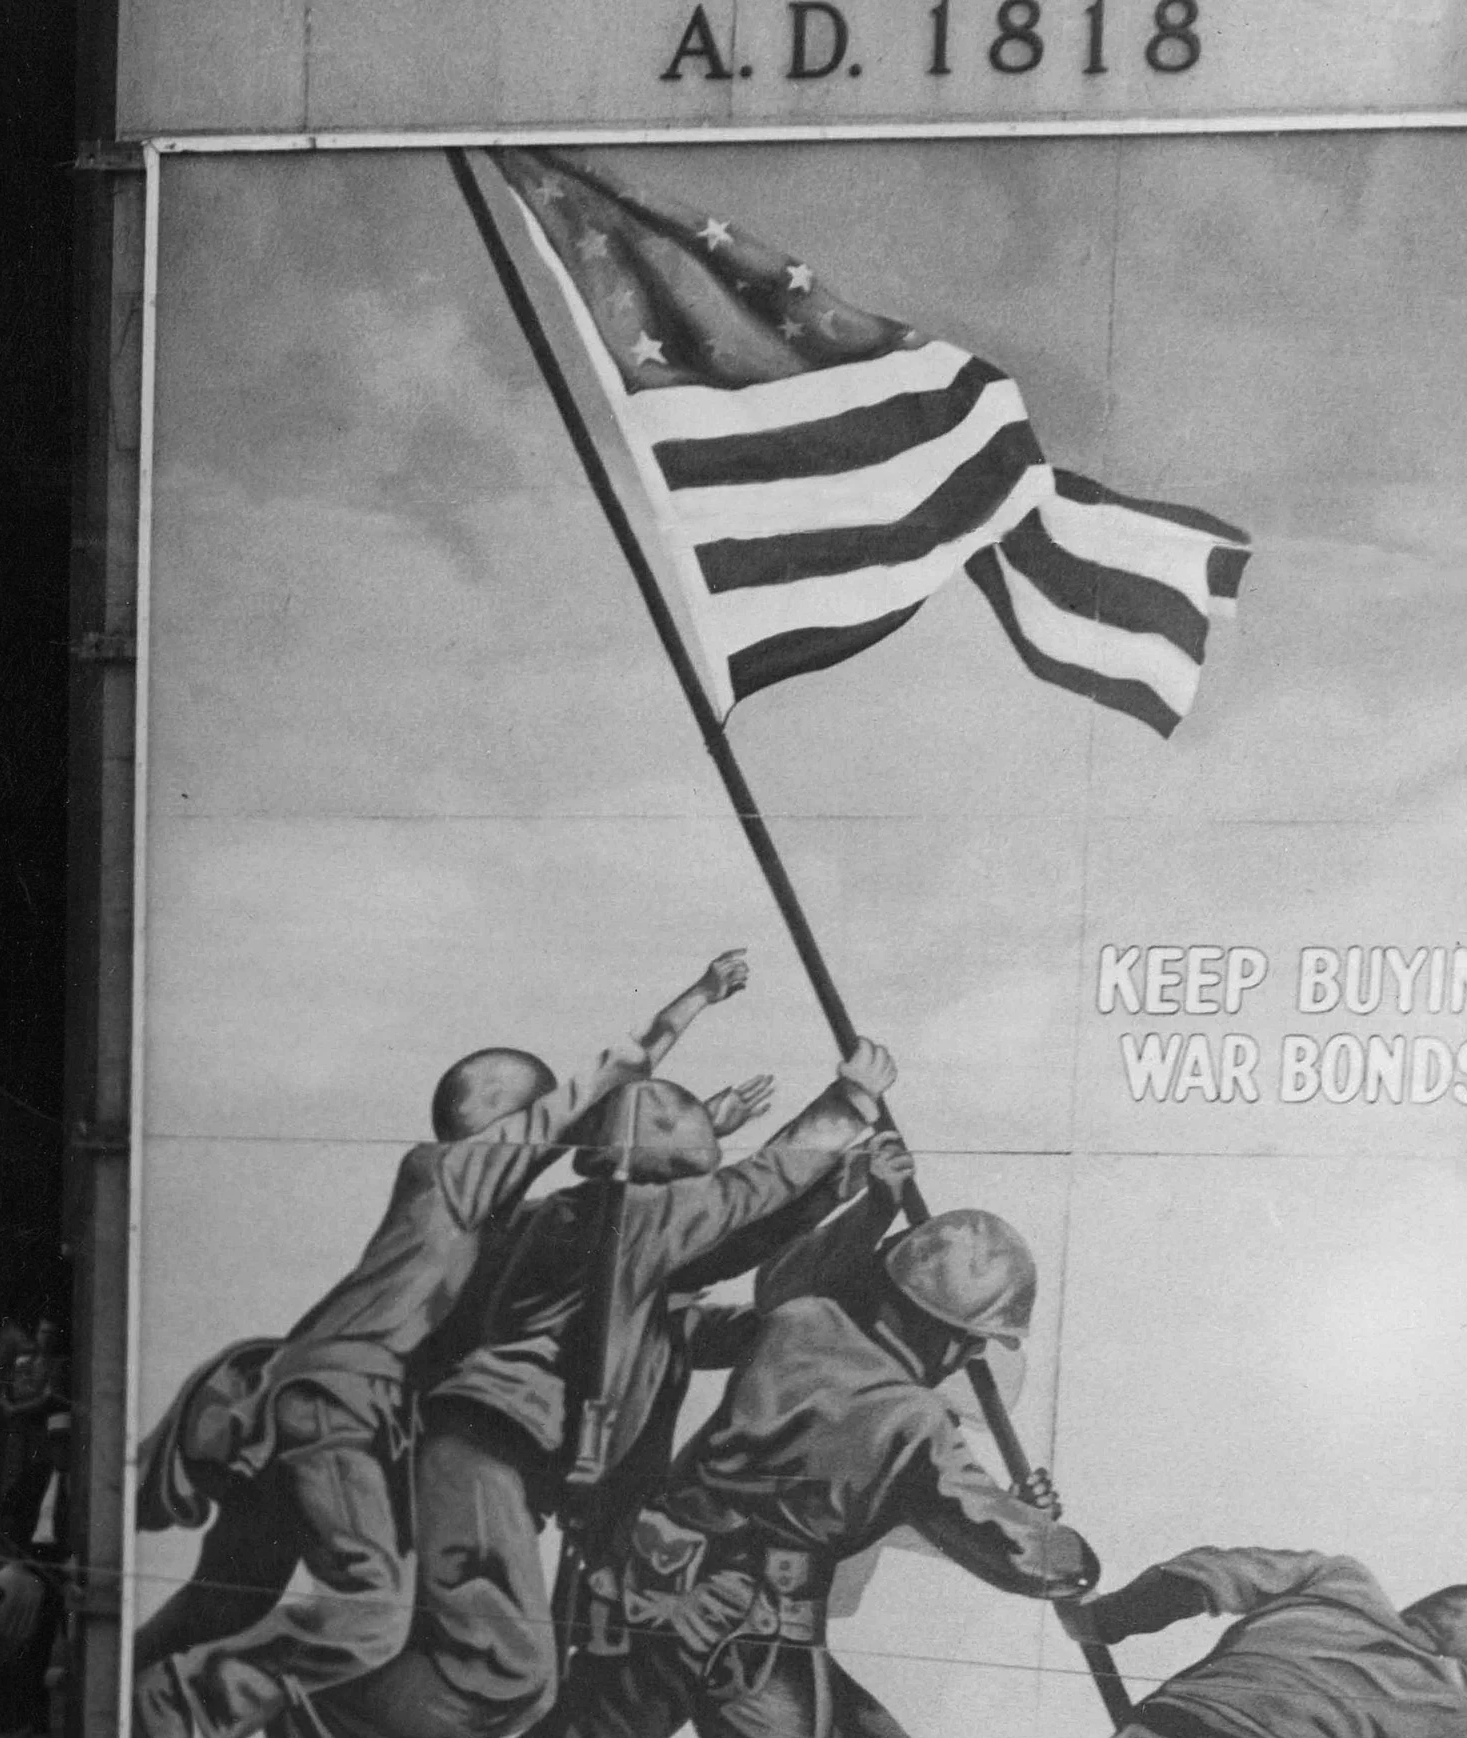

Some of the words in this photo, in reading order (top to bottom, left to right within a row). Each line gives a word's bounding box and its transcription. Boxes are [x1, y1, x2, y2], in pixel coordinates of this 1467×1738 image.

[926, 0, 1202, 76] 1818
[1096, 943, 1269, 1016] KEEP
[1119, 1032, 1262, 1104] WAR
